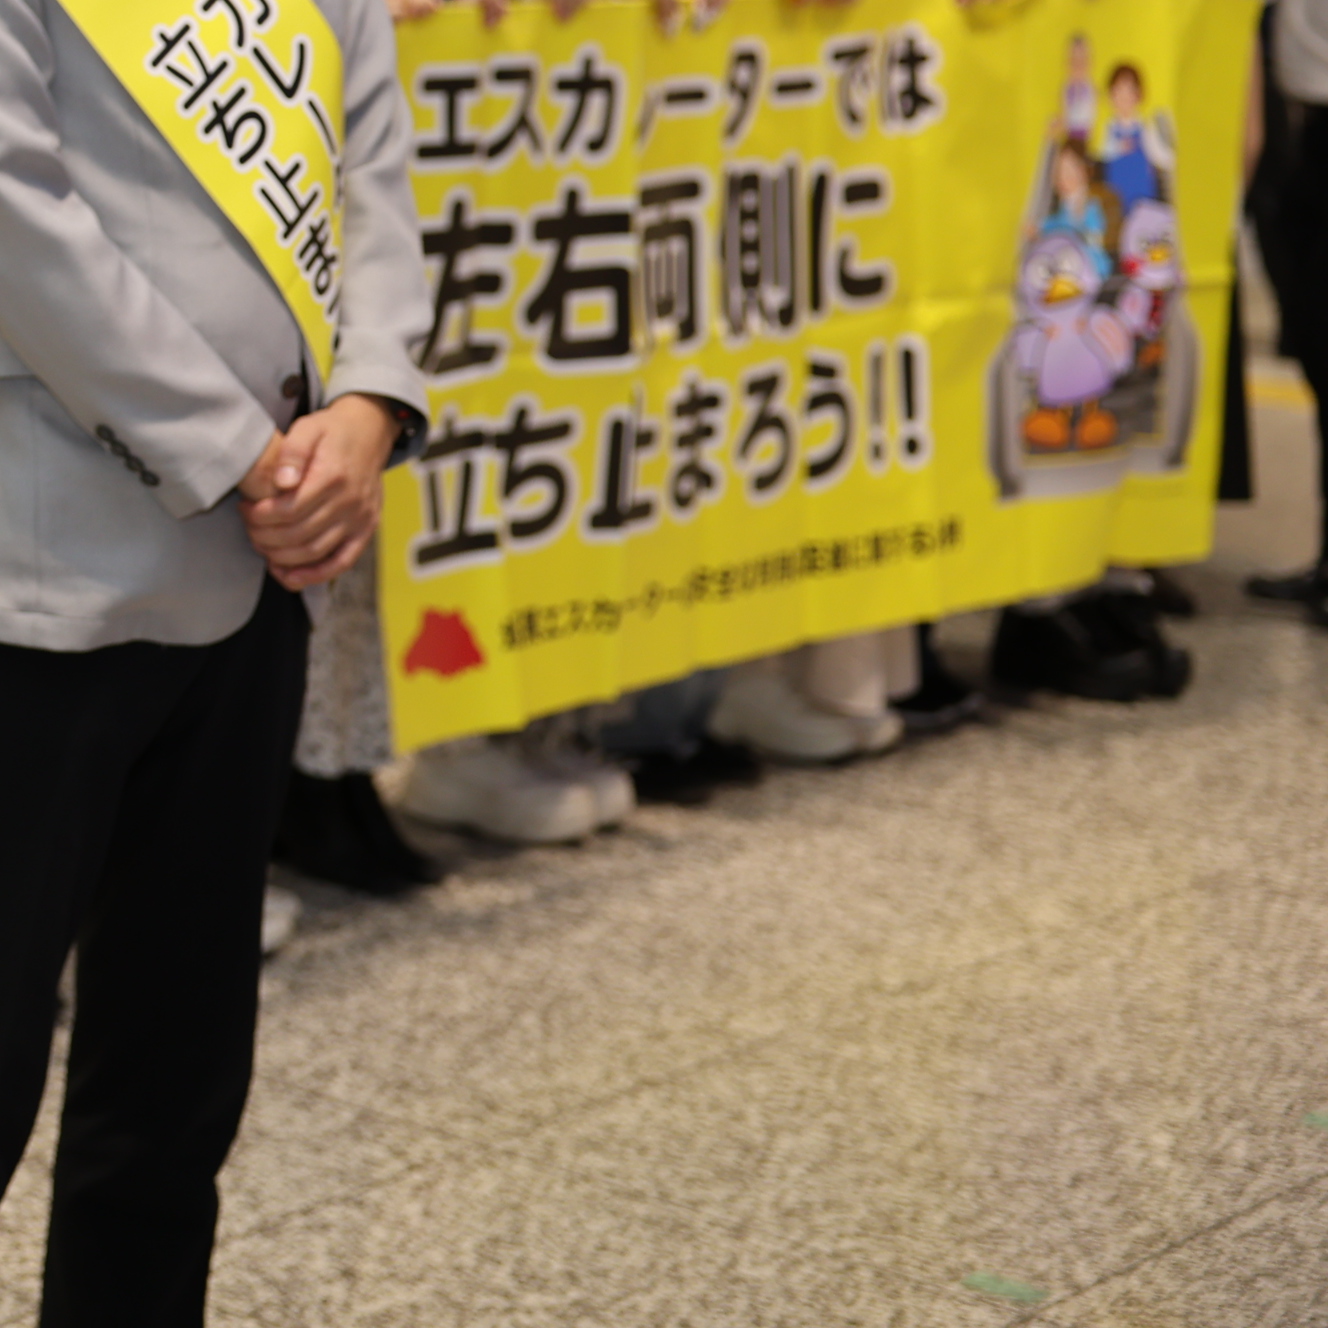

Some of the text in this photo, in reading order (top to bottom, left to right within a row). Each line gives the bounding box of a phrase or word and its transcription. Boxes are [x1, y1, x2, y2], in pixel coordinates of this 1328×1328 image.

[150, 23, 342, 352] 立ち止ま
[416, 36, 935, 160] エスカーターでは
[419, 162, 885, 372] 左右両側に
